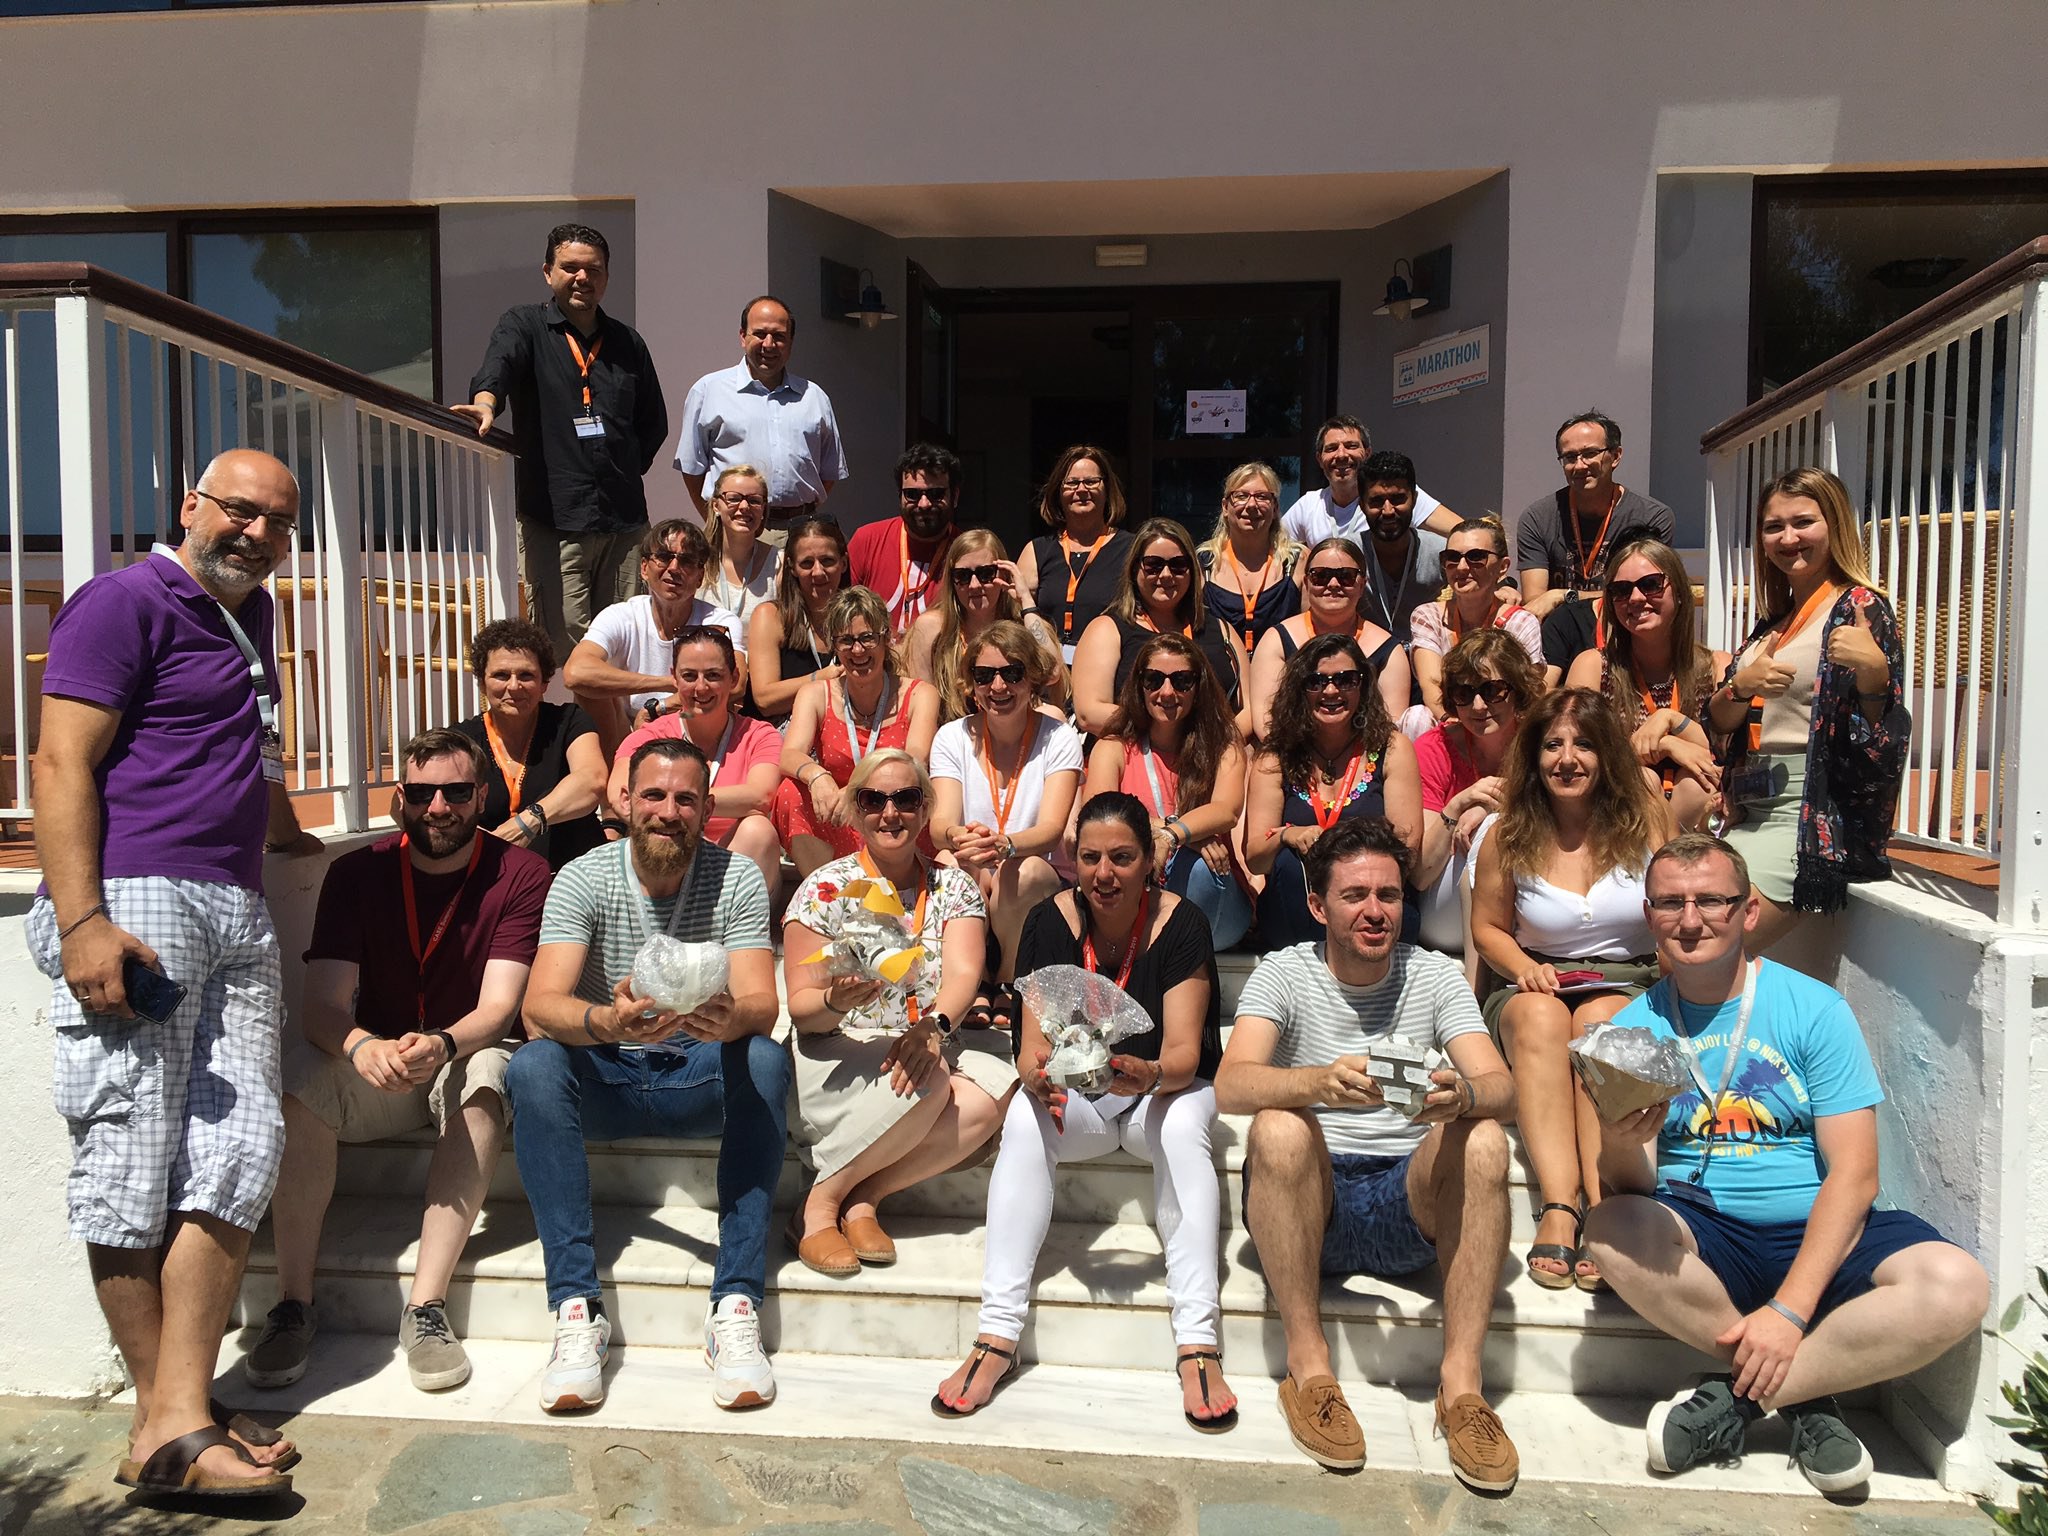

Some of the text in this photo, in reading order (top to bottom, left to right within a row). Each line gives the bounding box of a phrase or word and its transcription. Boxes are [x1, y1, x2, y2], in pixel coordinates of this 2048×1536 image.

[1416, 340, 1480, 376] MARATHON
[1747, 1038, 1760, 1052] @
[1759, 1044, 1790, 1075] NICK'S
[1786, 1074, 1808, 1104] DINER
